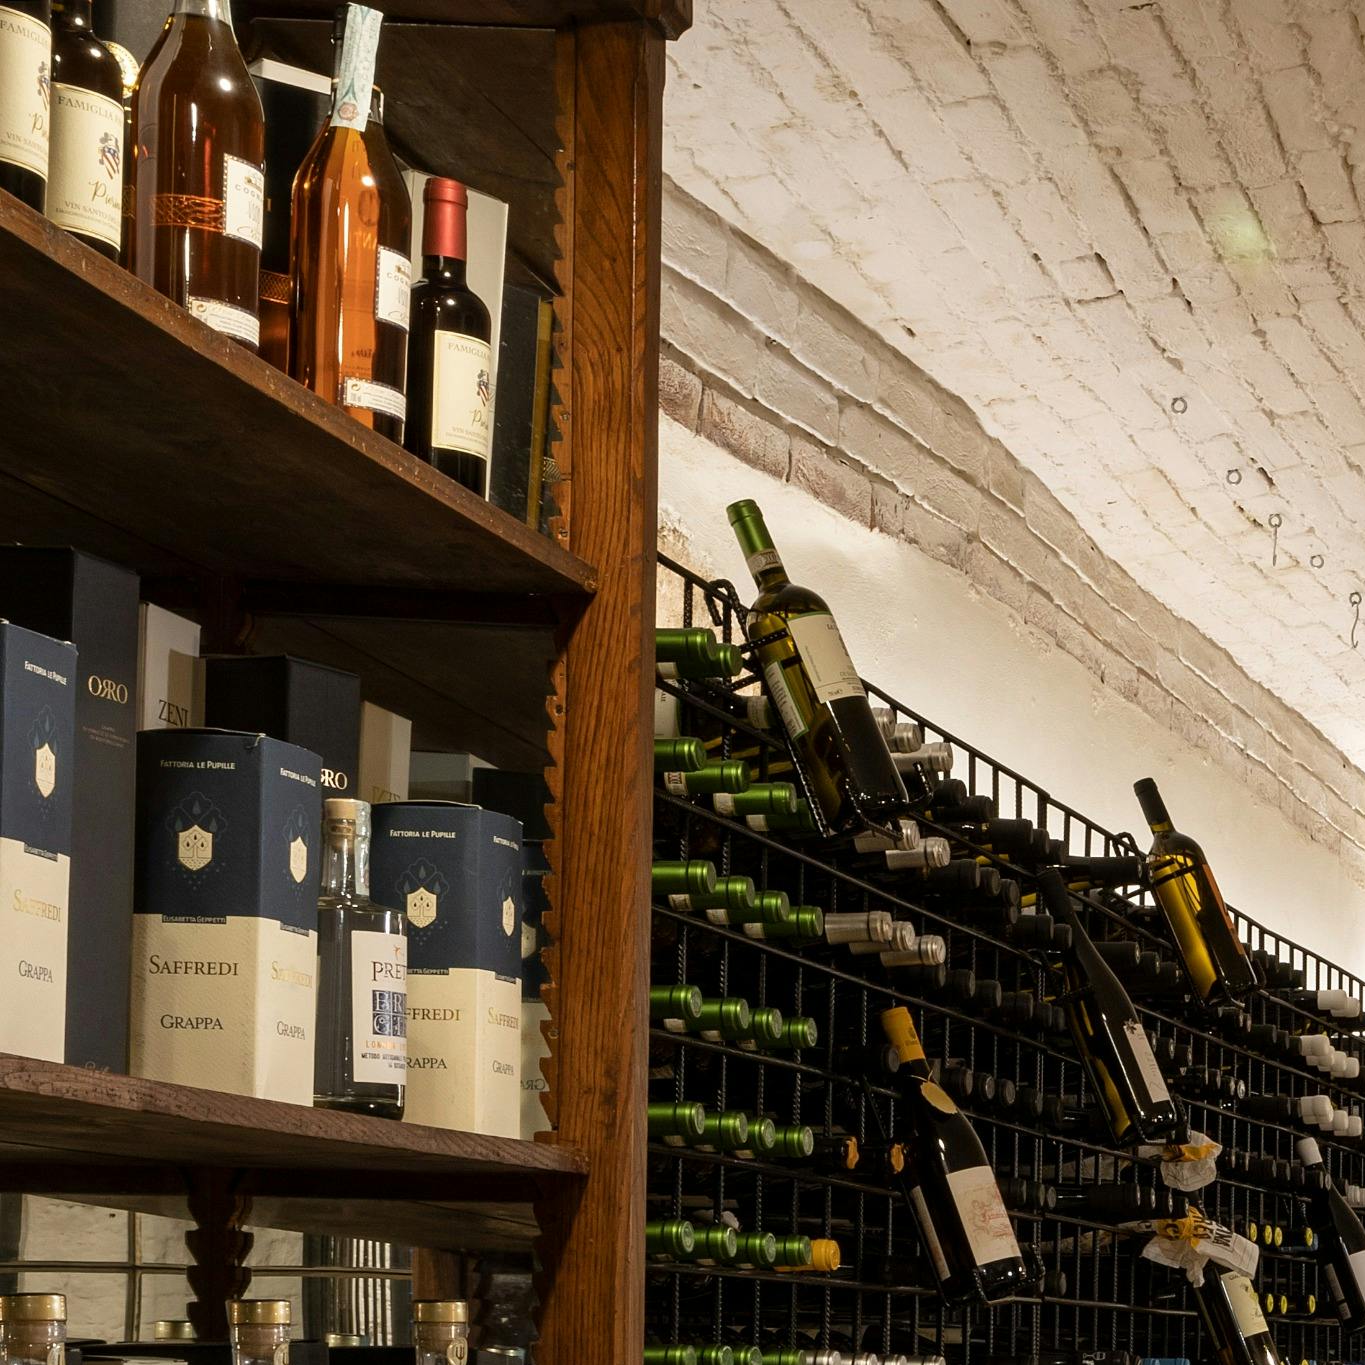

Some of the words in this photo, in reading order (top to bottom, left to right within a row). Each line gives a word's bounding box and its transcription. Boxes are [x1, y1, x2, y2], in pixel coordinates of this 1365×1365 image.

[160, 759, 194, 769] FATTORIA
[196, 760, 206, 769] LE
[206, 760, 236, 770] PUPILLE
[389, 829, 420, 839] FATTORIA
[421, 830, 430, 839] LE
[430, 829, 456, 839] PUPILLE
[18, 959, 54, 984] GRAPPA
[148, 954, 240, 977] SAFFREDI
[160, 1013, 225, 1031] GRAPPA
[405, 1008, 461, 1022] FFREDI
[487, 1006, 520, 1031] SAFFREDI
[276, 1020, 306, 1041] GRAPPA
[405, 1057, 448, 1070] RAPPA
